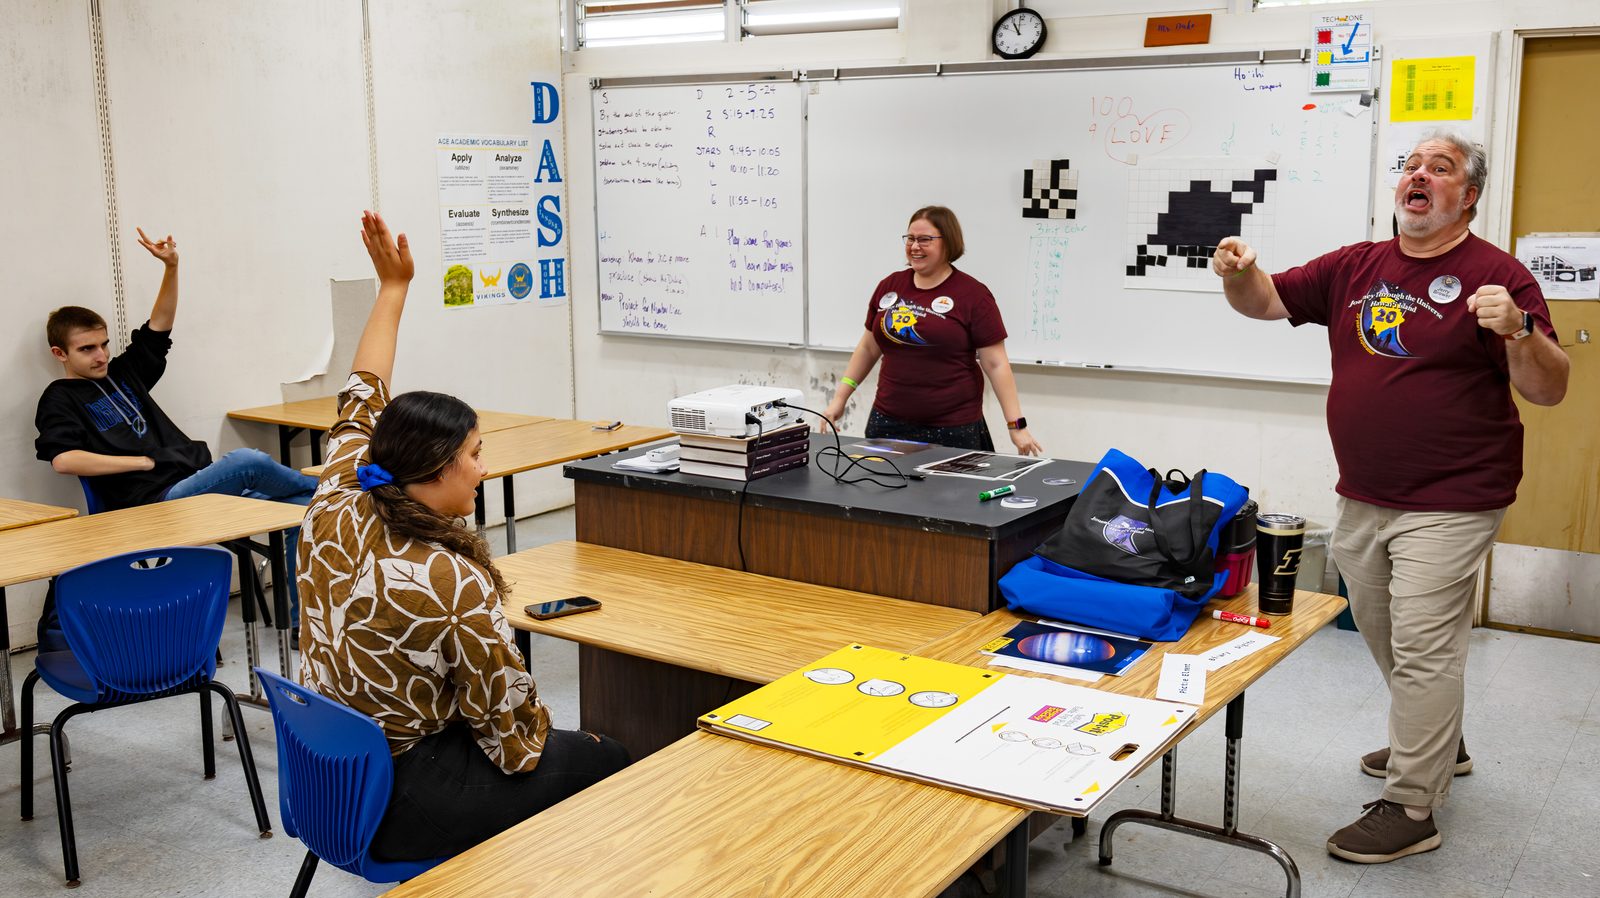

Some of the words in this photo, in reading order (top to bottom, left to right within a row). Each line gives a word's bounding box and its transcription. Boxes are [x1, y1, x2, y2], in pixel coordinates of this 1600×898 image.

[1091, 96, 1133, 119] 100
[708, 126, 716, 138] R
[1111, 123, 1177, 144] LOVE
[696, 146, 721, 155] STARS
[451, 153, 472, 163] Apply
[495, 153, 522, 164] Analyze
[449, 209, 480, 218] Evaluate
[492, 208, 529, 218] Synthesize
[1405, 293, 1417, 302] the
[1416, 298, 1444, 320] Universe
[895, 315, 910, 323] 20
[1375, 309, 1397, 323] 20
[1233, 616, 1249, 624] EXPO
[1089, 714, 1122, 733] Post-it
